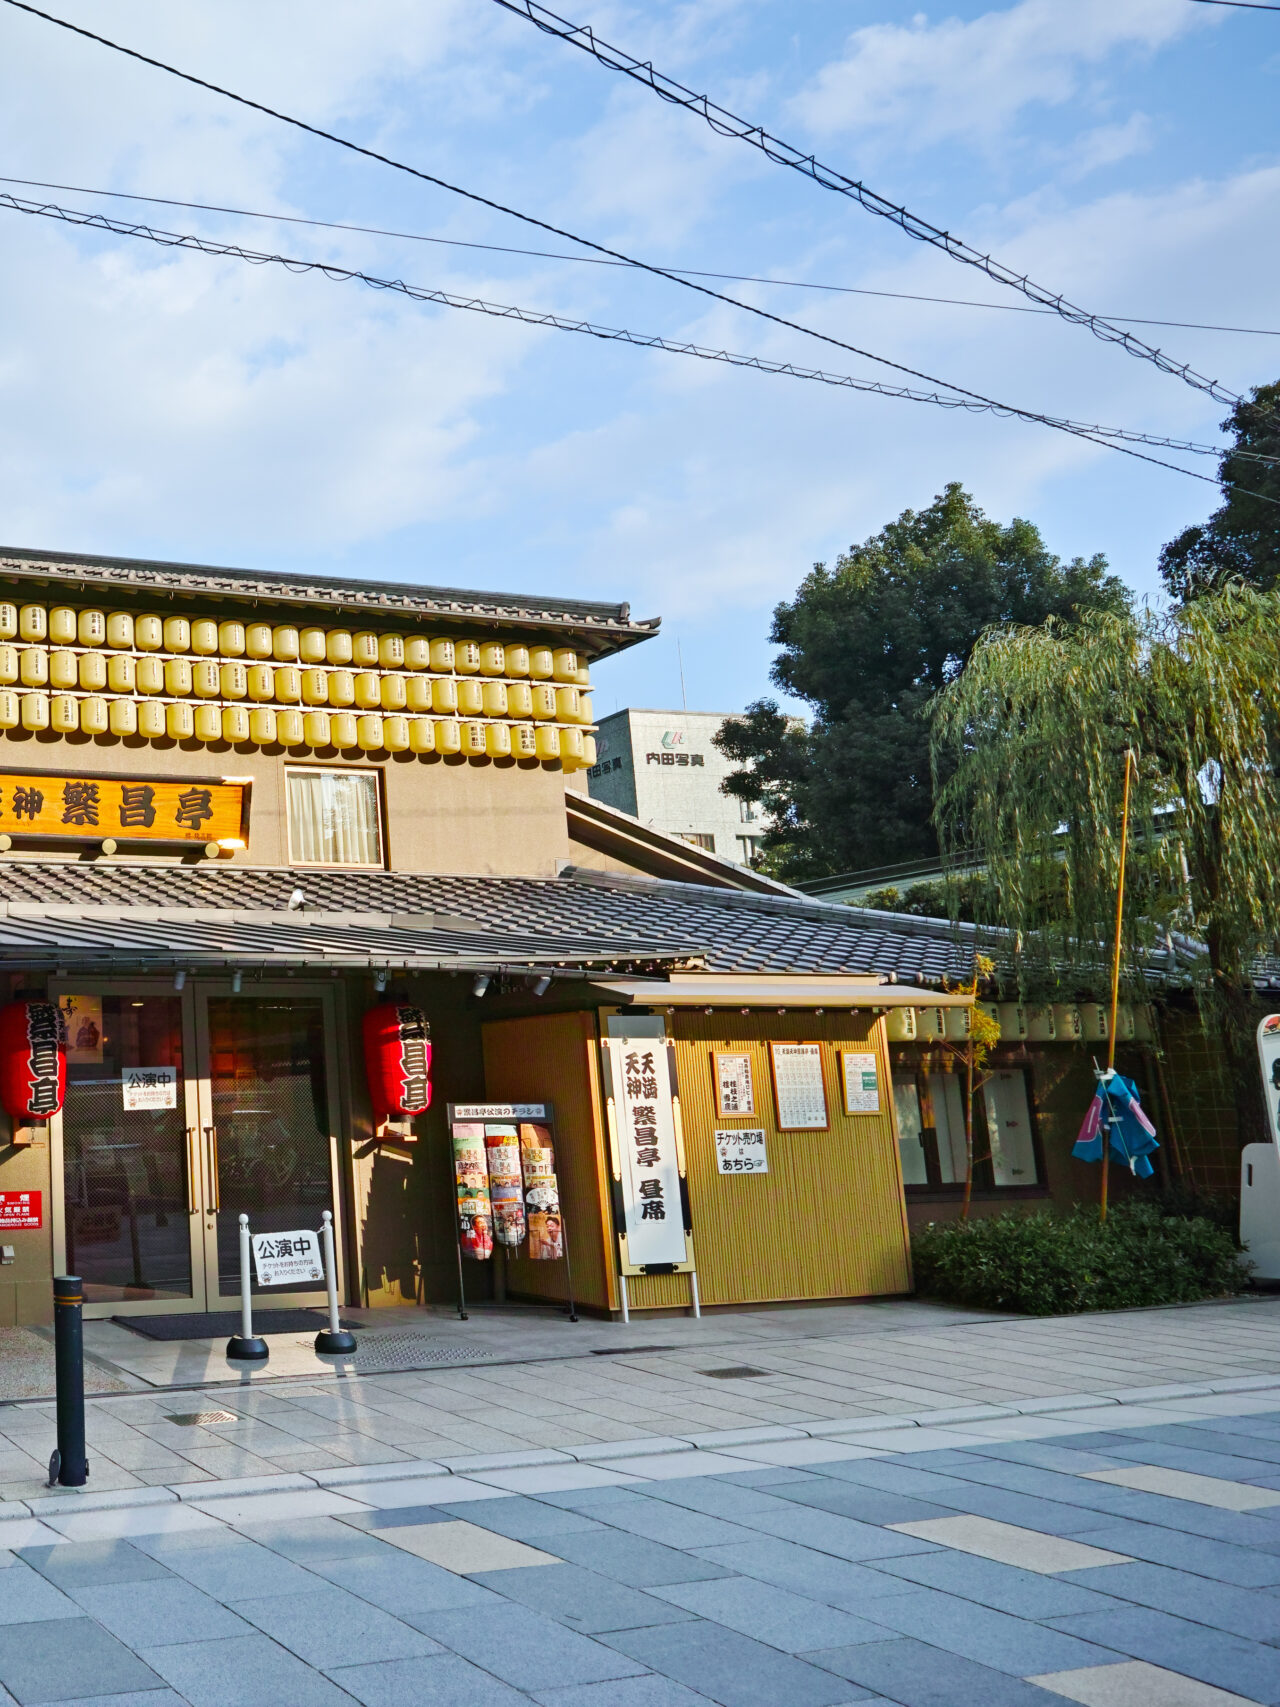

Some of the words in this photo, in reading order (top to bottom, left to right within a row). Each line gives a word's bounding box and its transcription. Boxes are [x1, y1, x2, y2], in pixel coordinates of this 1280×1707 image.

[646, 752, 705, 767] 内田写真
[128, 1072, 171, 1089] 公演中
[625, 1052, 641, 1100] 天神
[641, 1052, 658, 1100] 天満
[631, 1105, 662, 1168] 繁昌亭
[717, 1132, 764, 1145] チケット売り場
[722, 1158, 754, 1171] あちら
[639, 1179, 666, 1221] 昼席
[258, 1237, 311, 1259] 公演中
